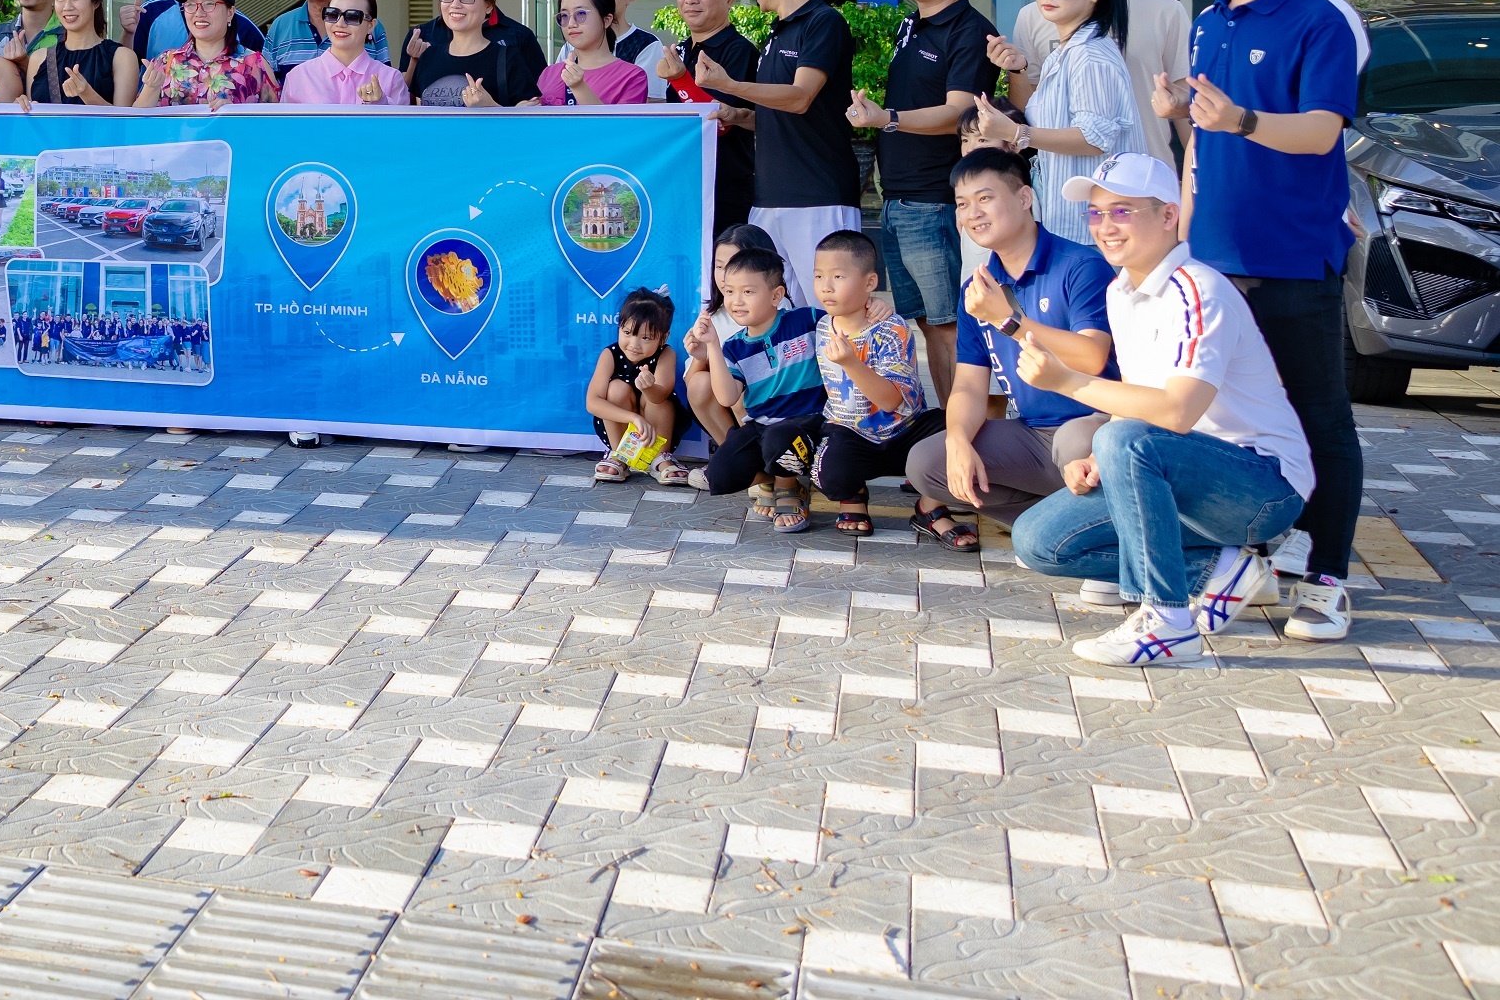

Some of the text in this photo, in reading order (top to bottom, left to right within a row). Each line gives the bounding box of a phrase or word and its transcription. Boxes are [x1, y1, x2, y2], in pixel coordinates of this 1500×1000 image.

[254, 300, 368, 317] TP. HỒ CHÍ MINH
[575, 311, 598, 324] HÀ
[420, 370, 488, 386] ĐÀ NẴNG
